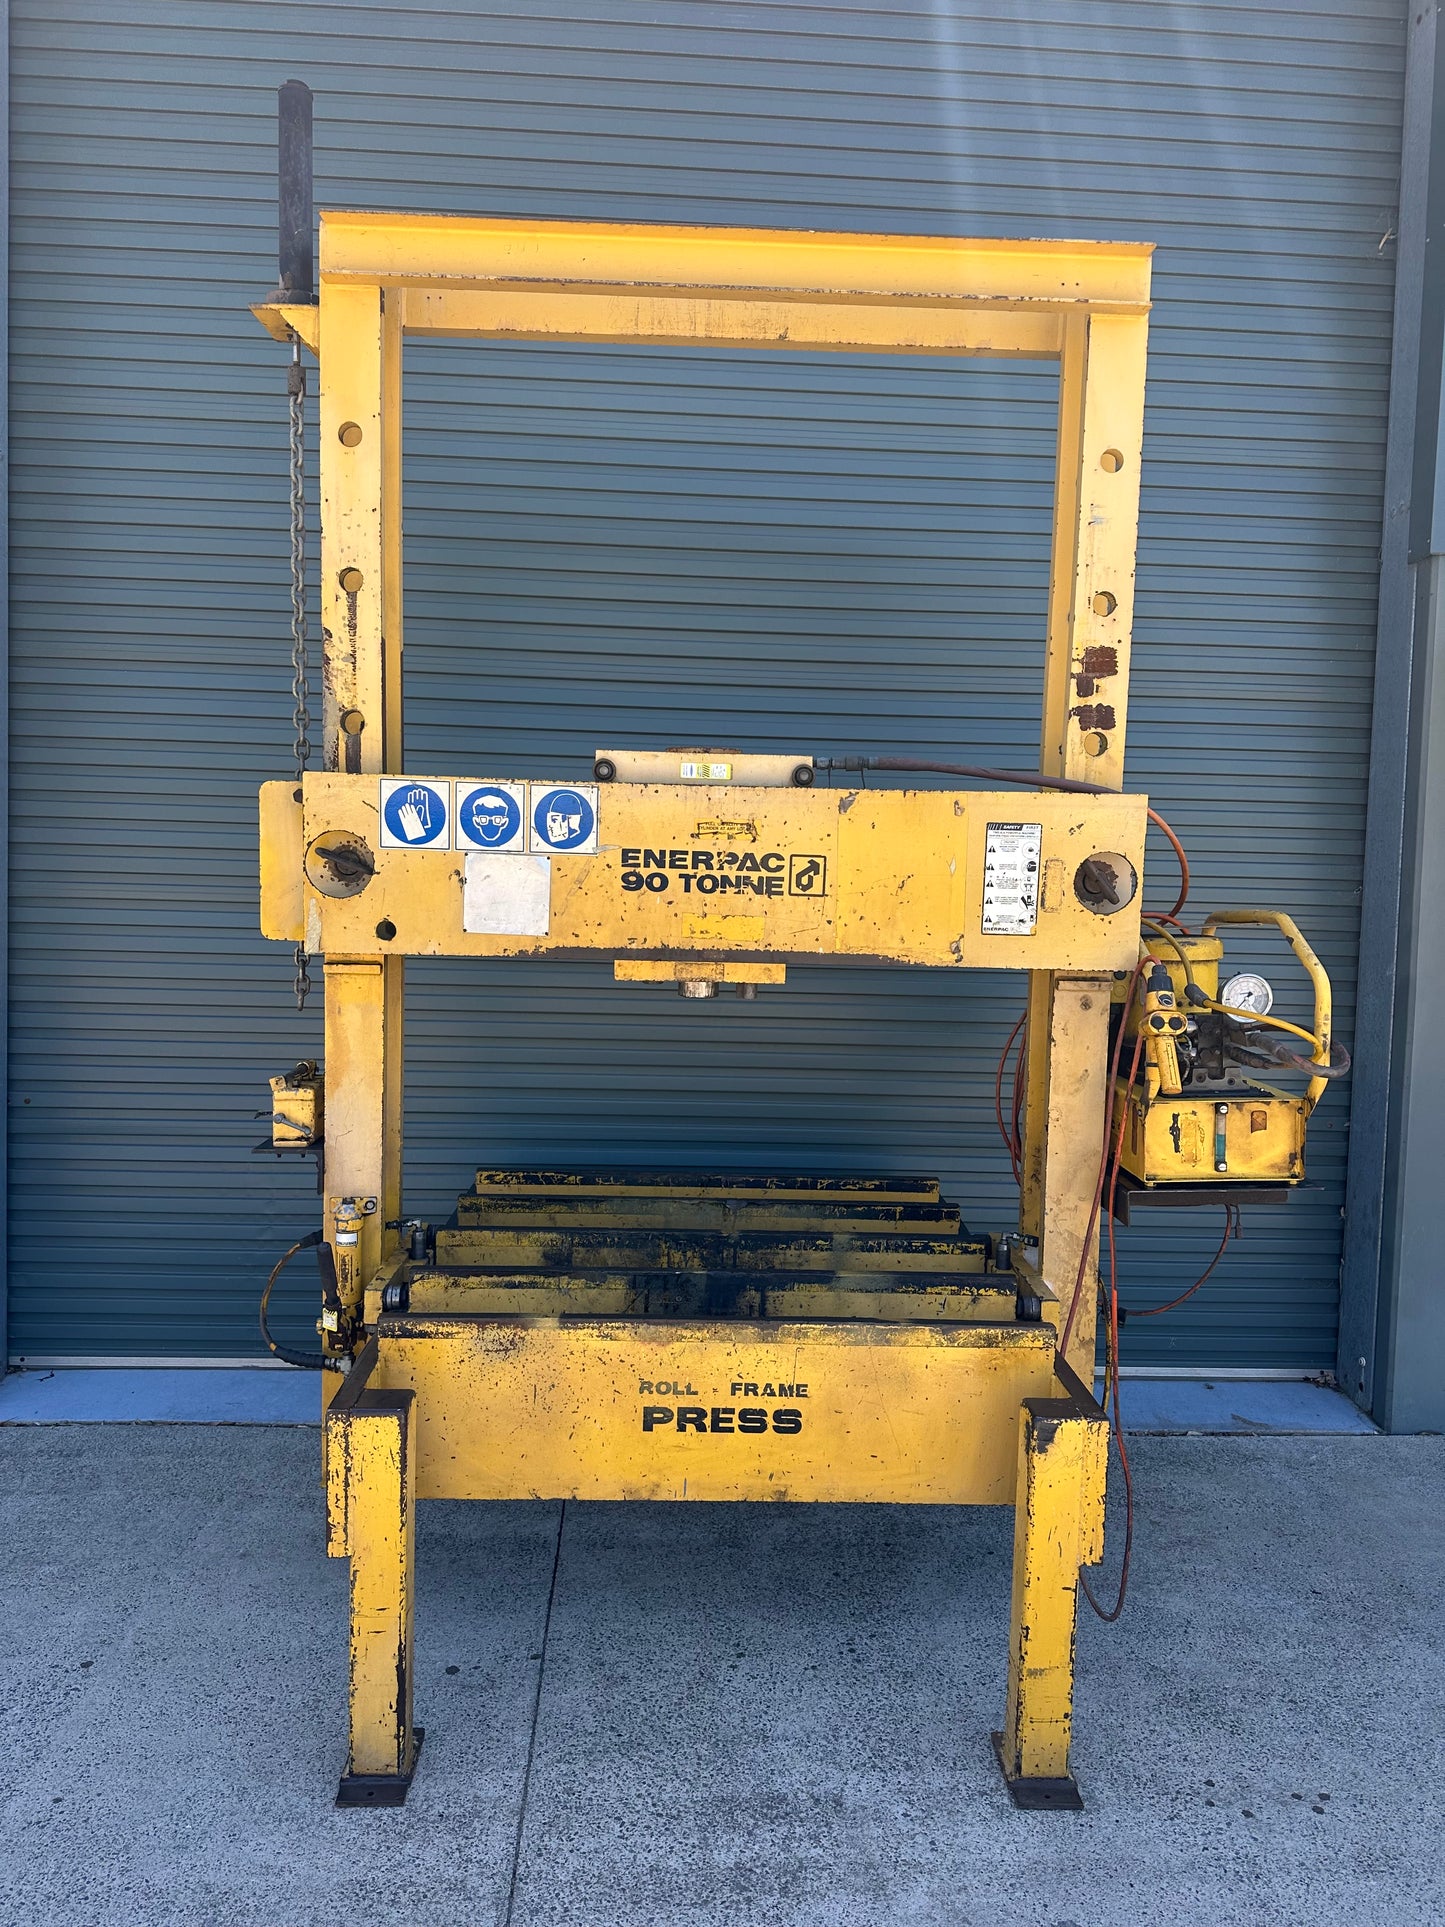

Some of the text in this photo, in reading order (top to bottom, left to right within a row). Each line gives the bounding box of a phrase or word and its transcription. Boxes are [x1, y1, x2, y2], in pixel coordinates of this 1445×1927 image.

[621, 848, 785, 873] ENERPAC
[621, 871, 785, 897] 90 TONNE
[639, 1381, 809, 1398] ROLL FRAME
[642, 1406, 803, 1435] PRESS
